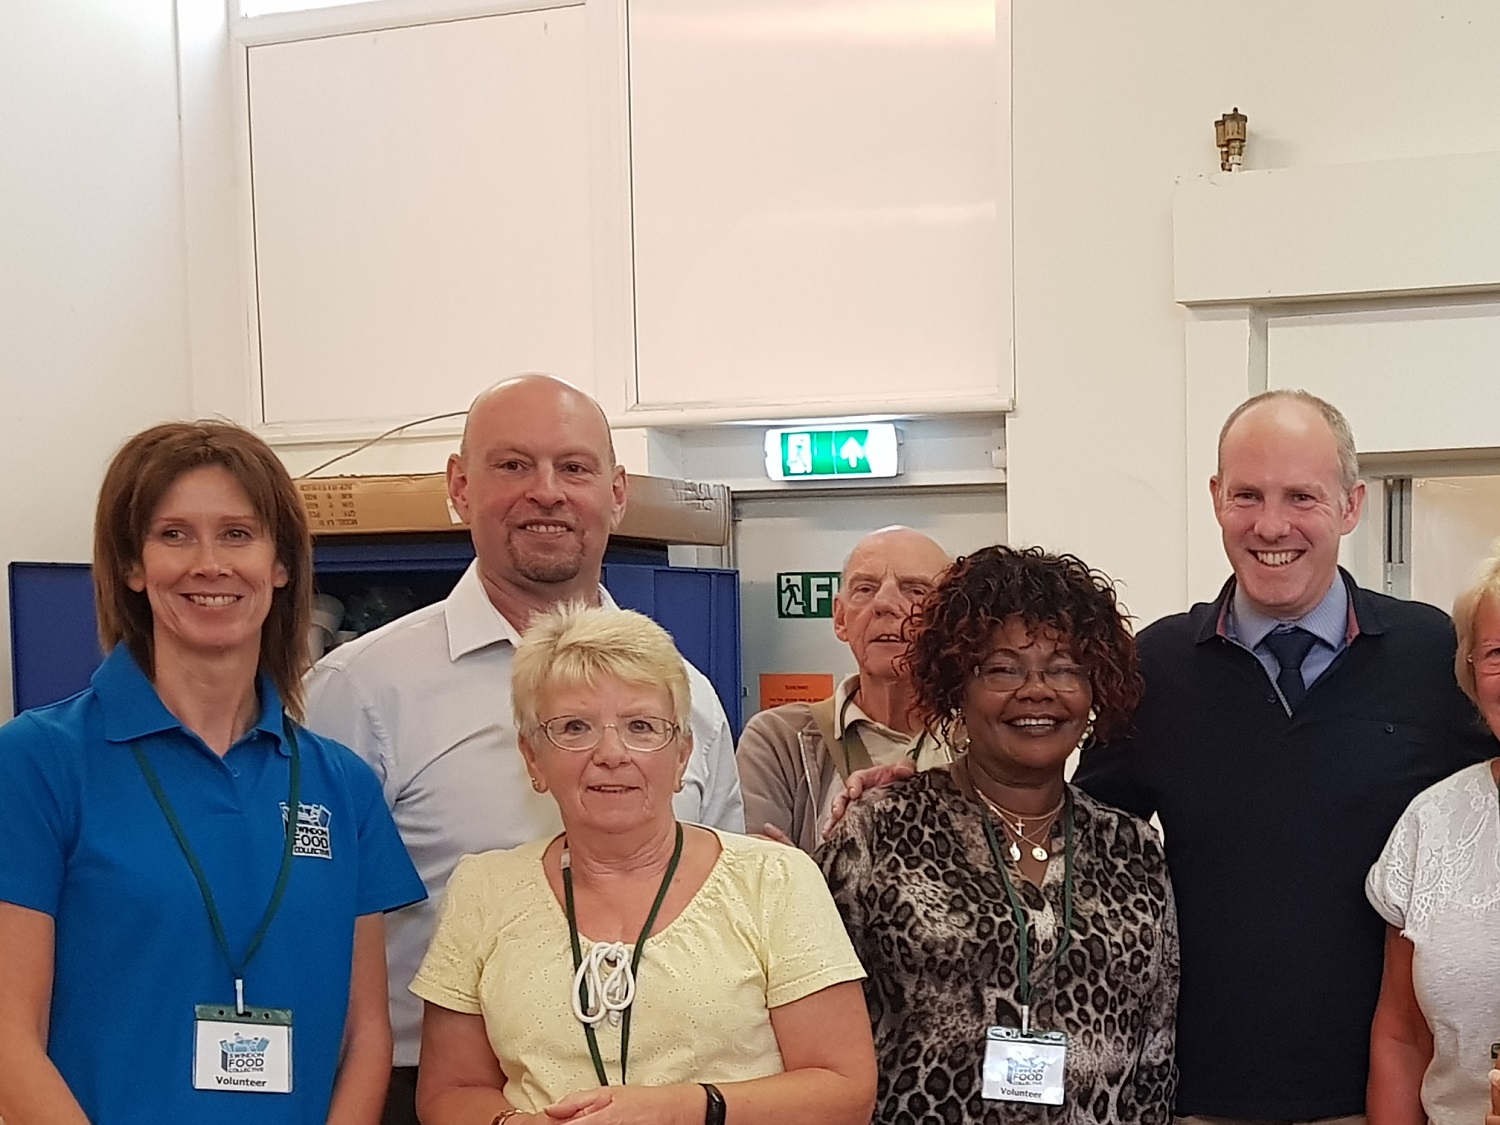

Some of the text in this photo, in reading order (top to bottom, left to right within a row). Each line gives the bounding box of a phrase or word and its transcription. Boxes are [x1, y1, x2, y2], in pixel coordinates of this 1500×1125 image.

[228, 1058, 264, 1068] FOOD
[215, 1076, 267, 1087] Volunteer
[1013, 1073, 1043, 1081] FOOD
[1000, 1087, 1042, 1098] Volunteer
